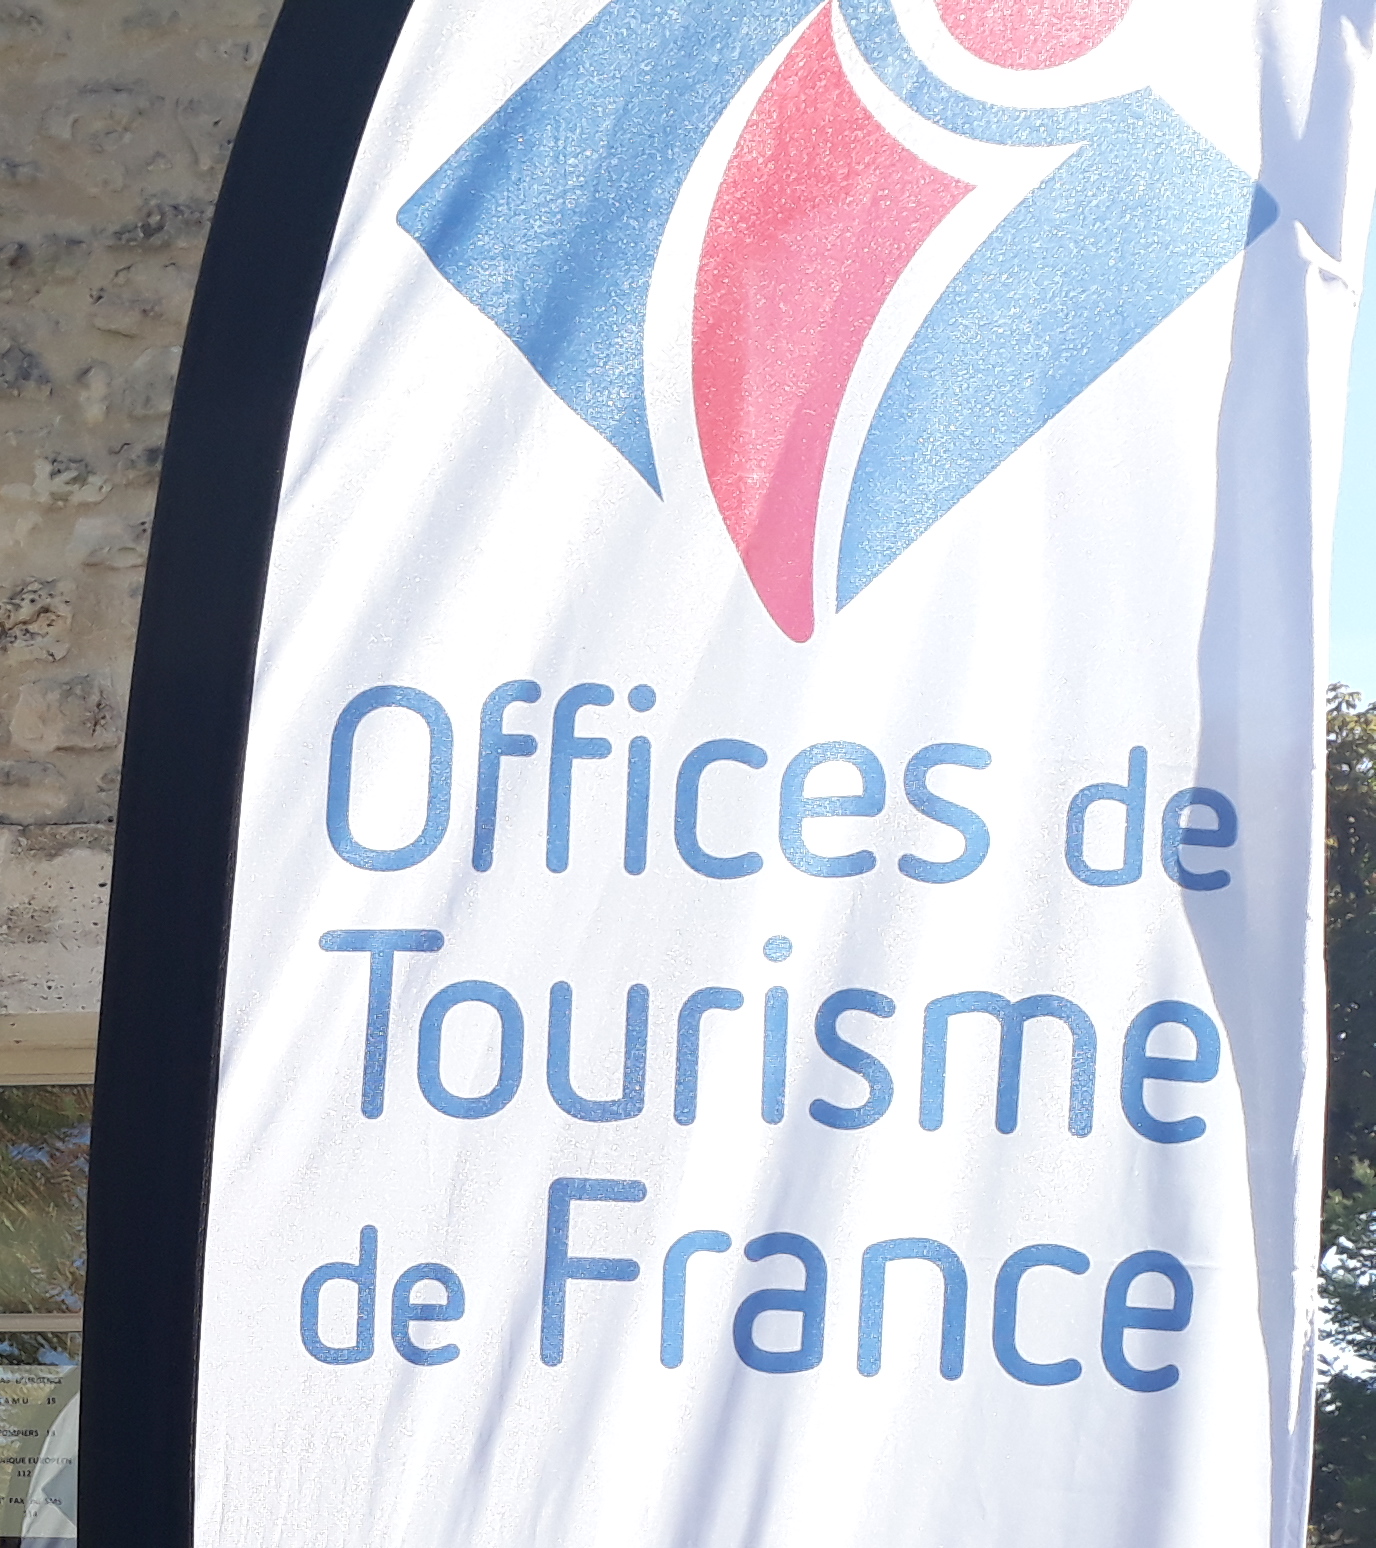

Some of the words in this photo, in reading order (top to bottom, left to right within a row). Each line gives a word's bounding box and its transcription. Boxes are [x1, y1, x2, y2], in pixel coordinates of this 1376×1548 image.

[326, 679, 992, 885] Offices
[1066, 745, 1241, 895] de
[320, 929, 1222, 1145] Tourisme
[301, 1225, 466, 1366] de
[540, 1177, 1195, 1393] France
